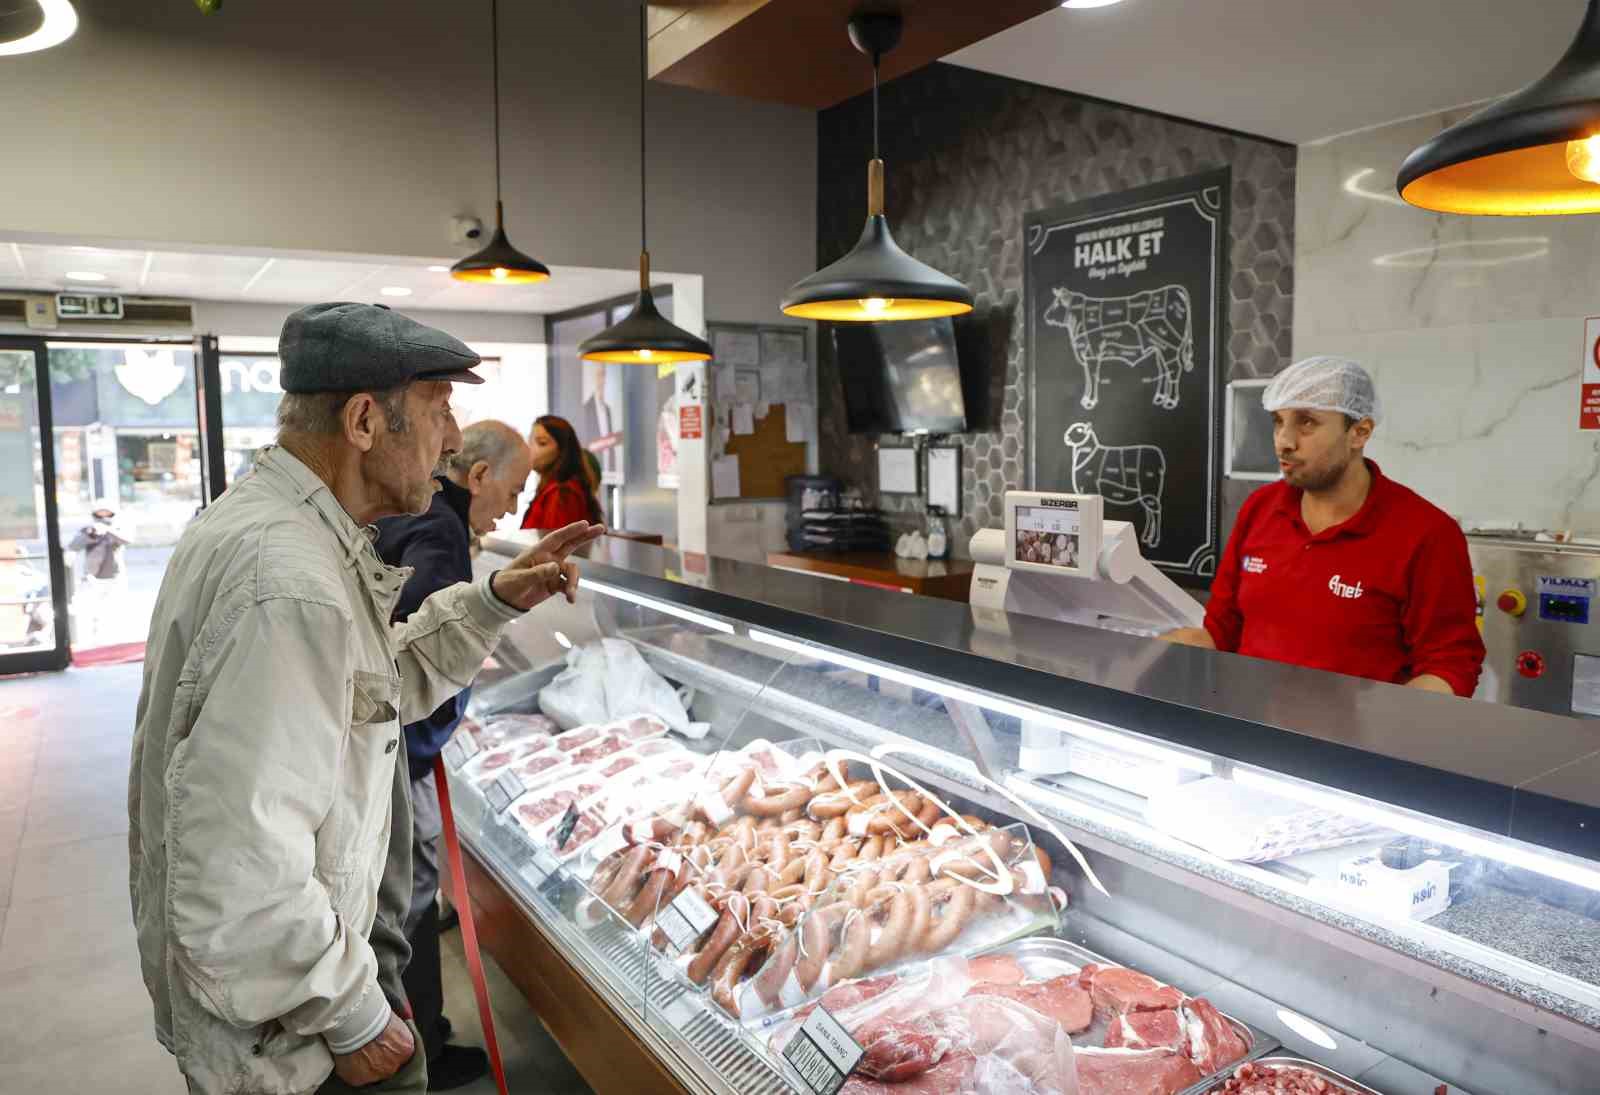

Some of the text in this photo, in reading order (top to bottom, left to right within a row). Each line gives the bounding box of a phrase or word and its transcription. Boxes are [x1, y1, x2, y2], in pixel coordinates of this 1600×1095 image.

[1074, 236, 1132, 269] HALK
[1138, 230, 1165, 257] ET
[1328, 574, 1364, 599] Anet
[1541, 577, 1590, 588] YILMAZ
